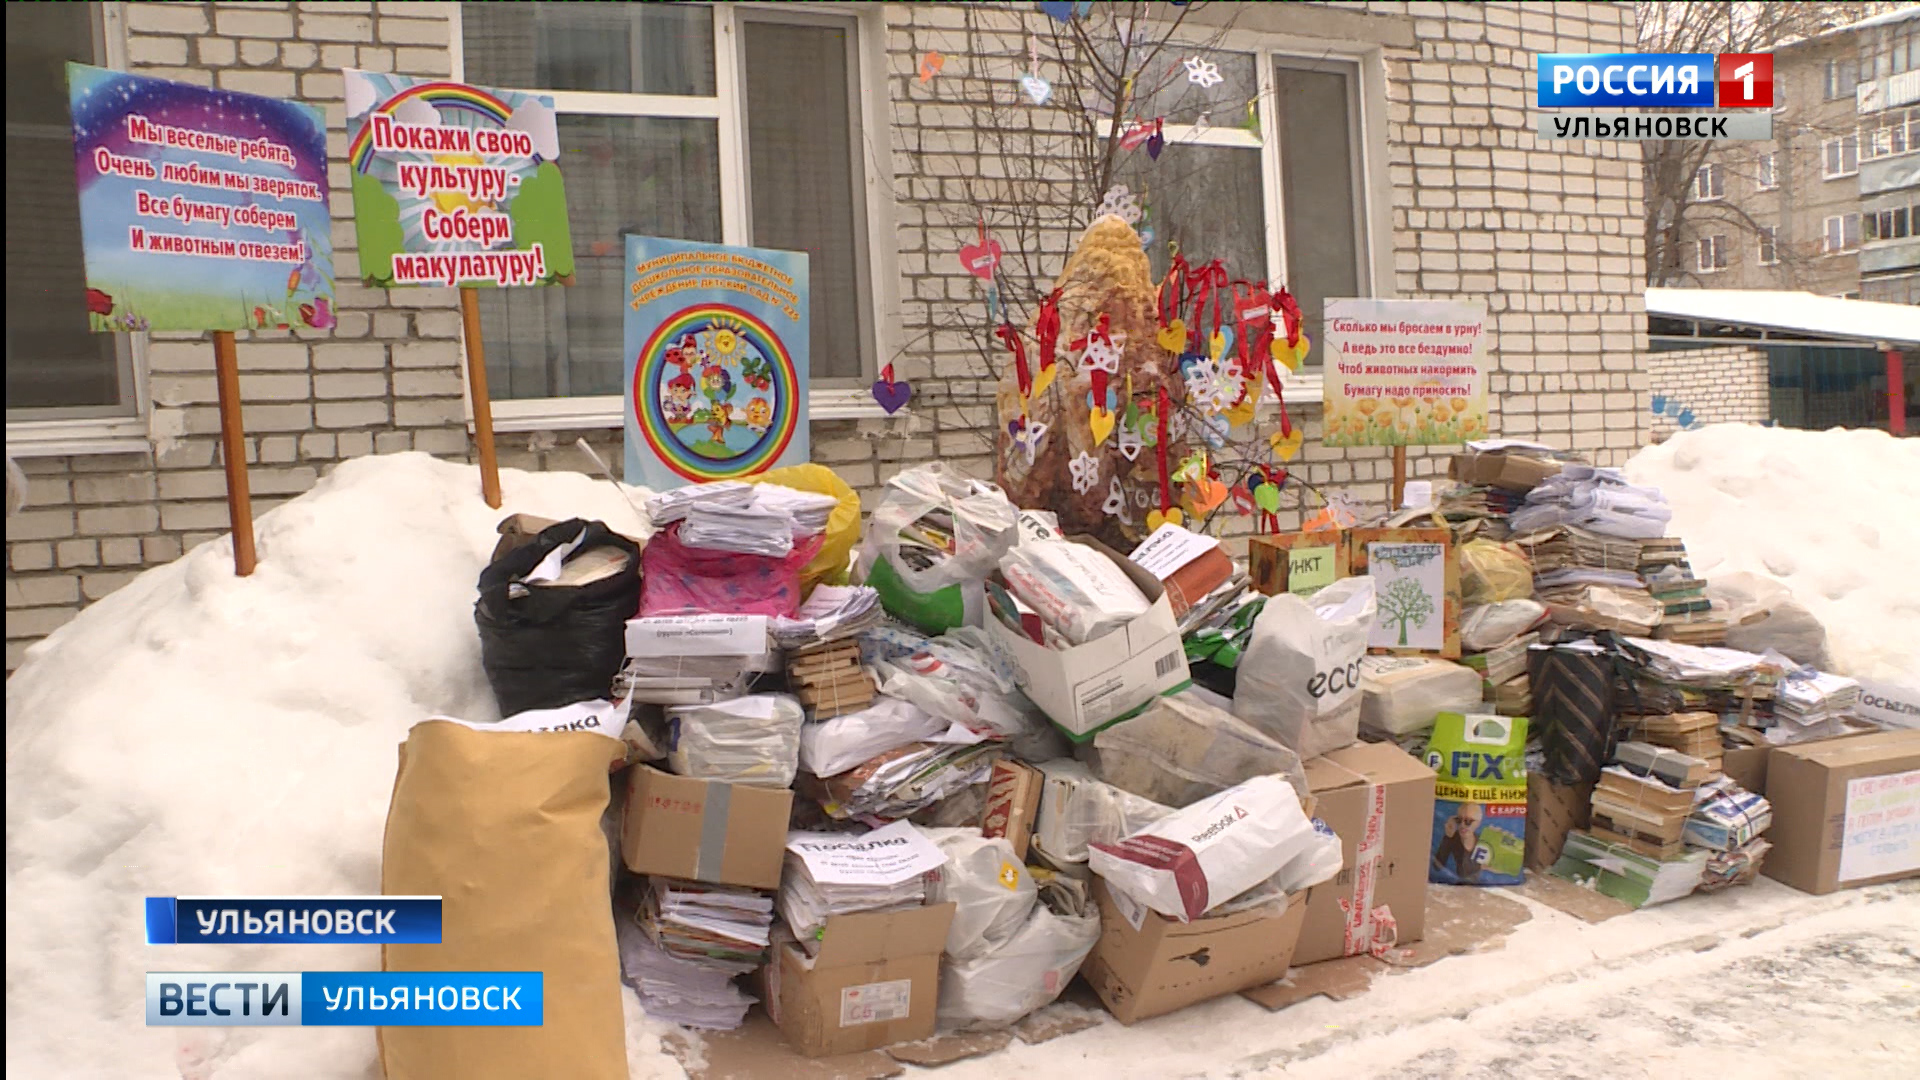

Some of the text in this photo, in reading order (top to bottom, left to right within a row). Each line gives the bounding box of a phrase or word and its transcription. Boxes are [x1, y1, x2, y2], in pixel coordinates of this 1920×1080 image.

[130, 117, 295, 166] Мы веселые ребята,
[374, 116, 531, 156] Покажи свою
[97, 150, 321, 200] Очень любим мы зверяток.
[400, 165, 506, 198] культуру
[138, 192, 296, 233] Все бумагу соберем
[424, 209, 509, 246] Собери
[131, 228, 304, 262] И животным отвезем!
[395, 247, 544, 286] макулатуру!
[636, 251, 794, 286] МУНИЦИПАЛЬНОЕ БЮДЖЕТНОЕ
[630, 278, 698, 311] УЧРЕЖДЕНИЕ
[749, 286, 769, 302] САД
[631, 264, 798, 305] ДОШКОЛЬНОЕ ОБРАЗОВАТЕЛЬНОЕ
[1333, 319, 1482, 337] Сколько мы бросаем в урну!
[1342, 342, 1473, 357] А ведь это все бездумно!
[1338, 362, 1477, 377] Чтоб животных накормить
[1344, 383, 1471, 398] Бумагу надо приносить!
[1451, 751, 1505, 780] FIX
[1435, 785, 1469, 800] ЦЕНЫ
[1472, 787, 1497, 800] ЕЩЁ
[798, 837, 909, 853] Посылка
